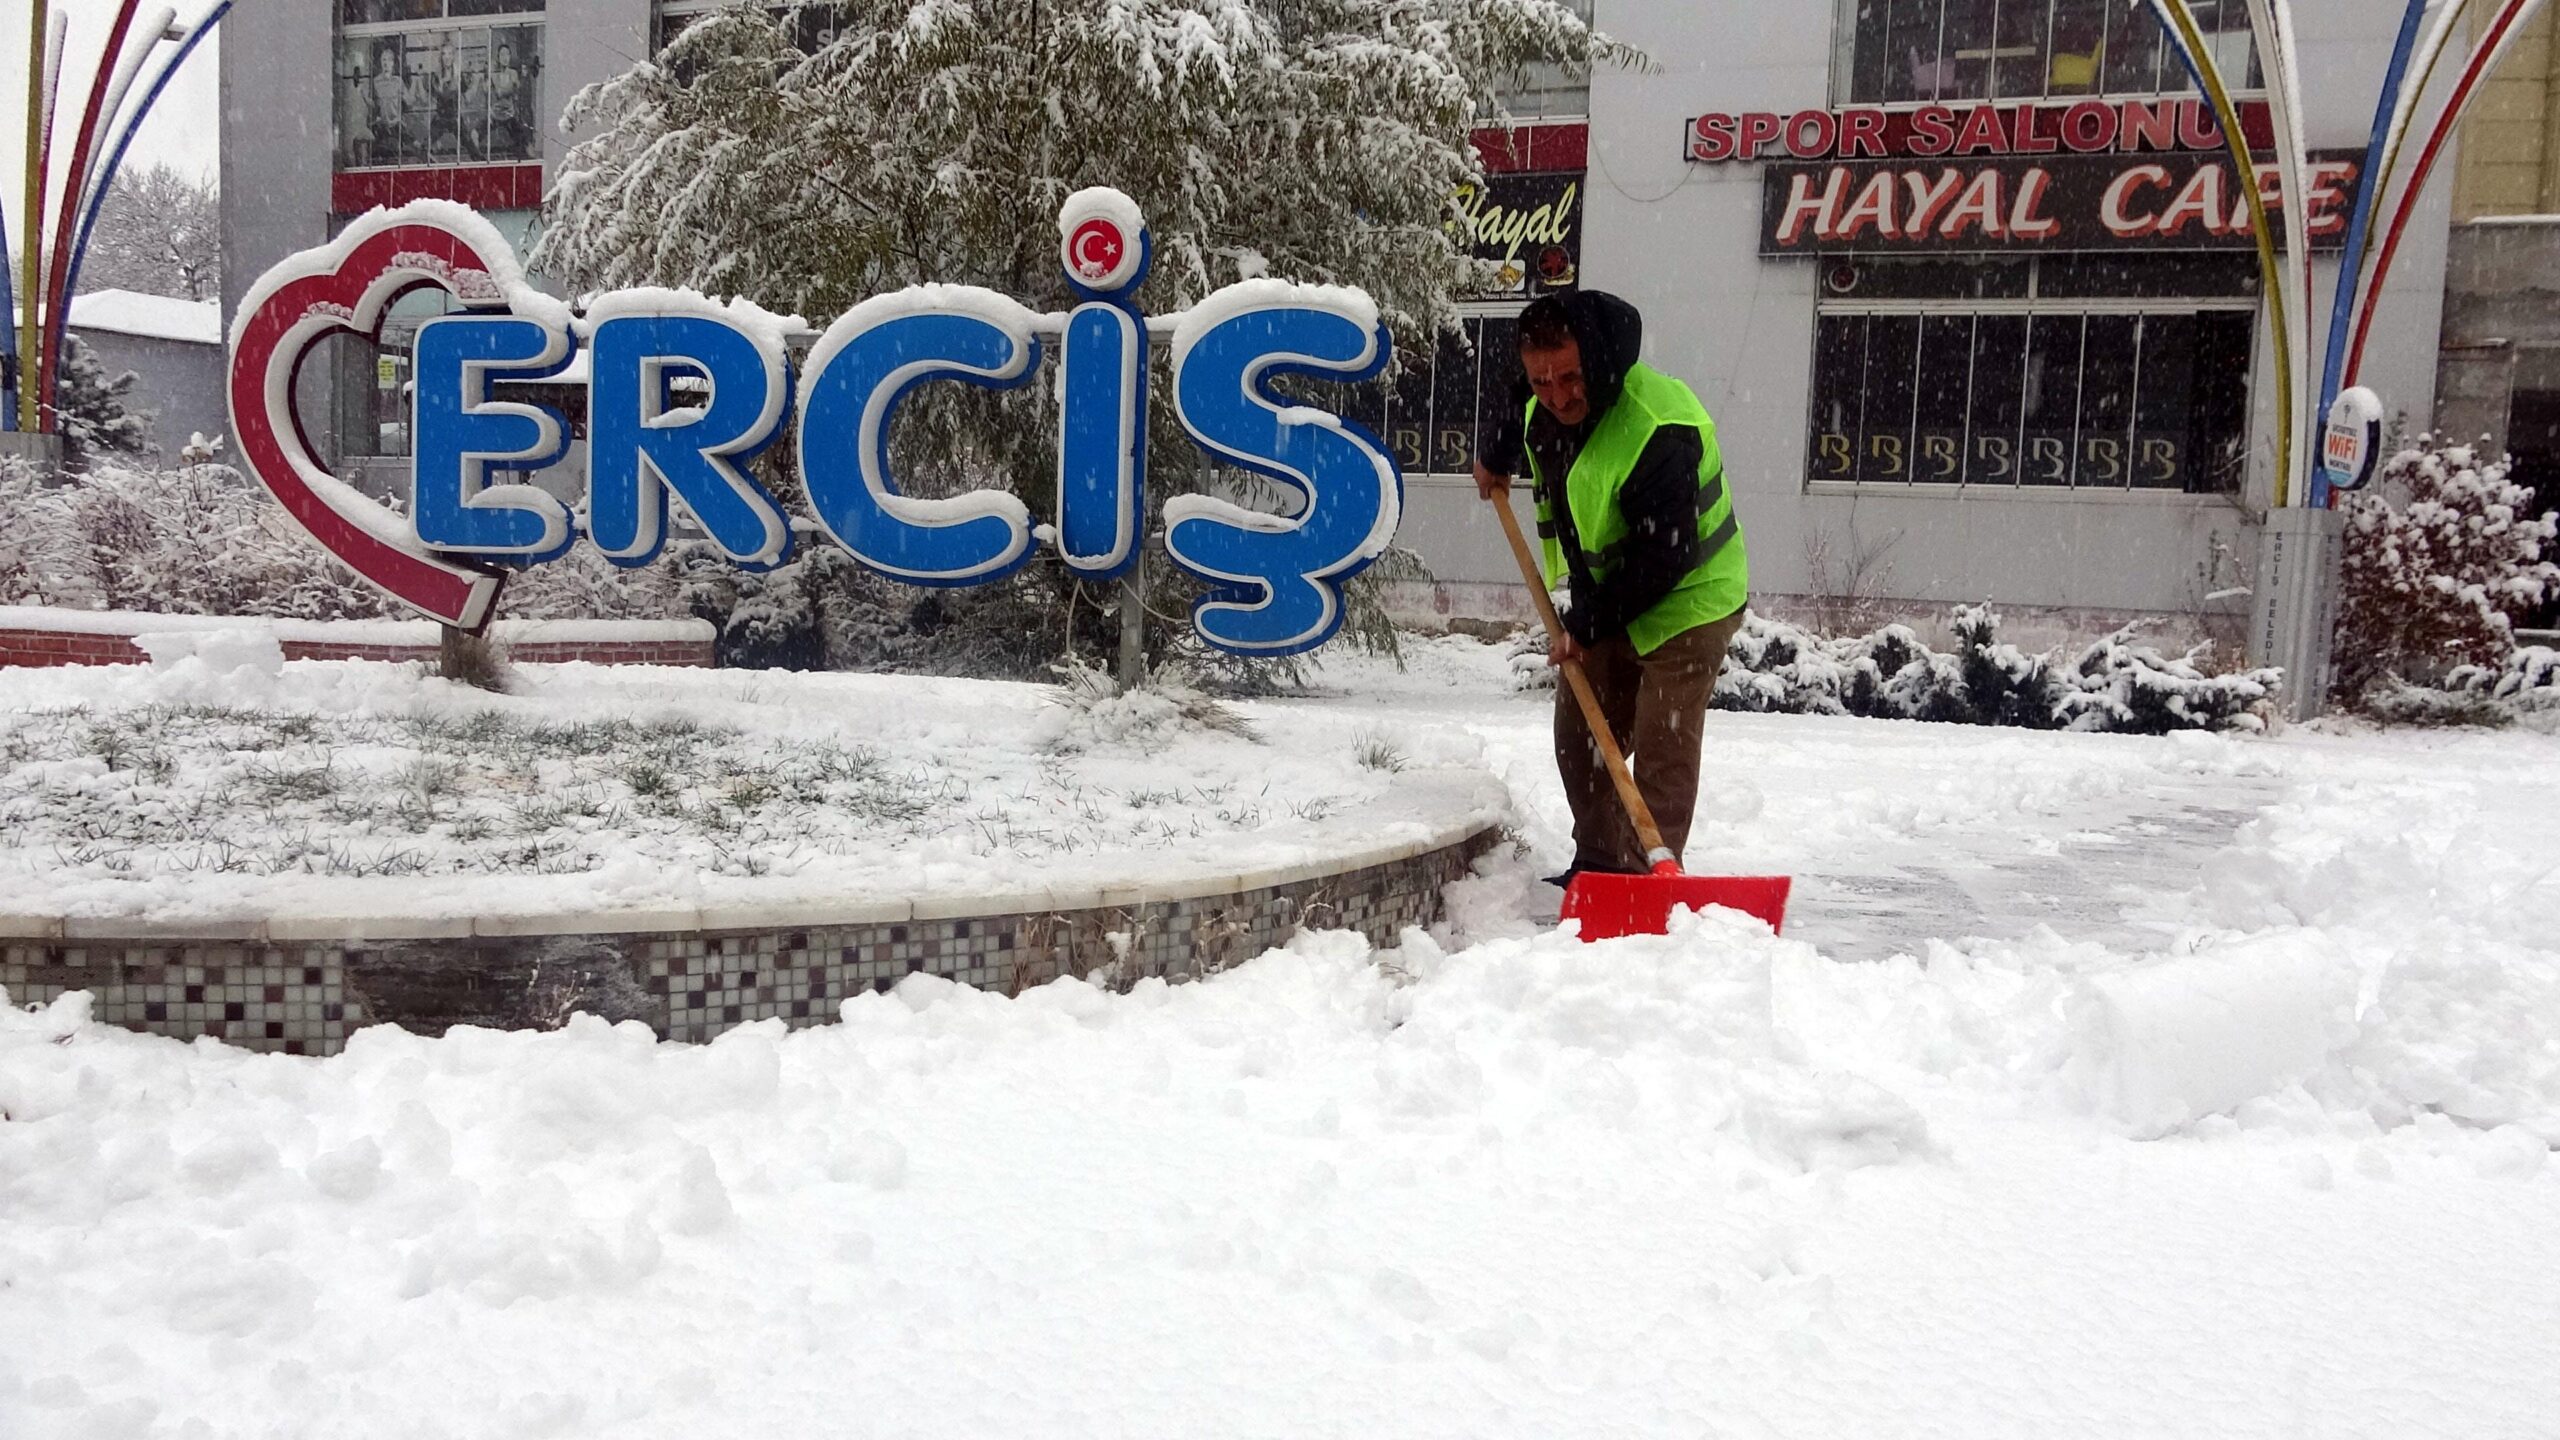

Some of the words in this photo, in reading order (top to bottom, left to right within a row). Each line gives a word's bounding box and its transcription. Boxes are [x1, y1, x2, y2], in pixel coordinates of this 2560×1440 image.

[1692, 110, 1888, 162] SPOR
[1906, 99, 2226, 155] SALONU
[1776, 165, 2060, 246] HAYAL
[2100, 161, 2358, 238] CAFE
[411, 195, 1406, 657] ERCİŞ
